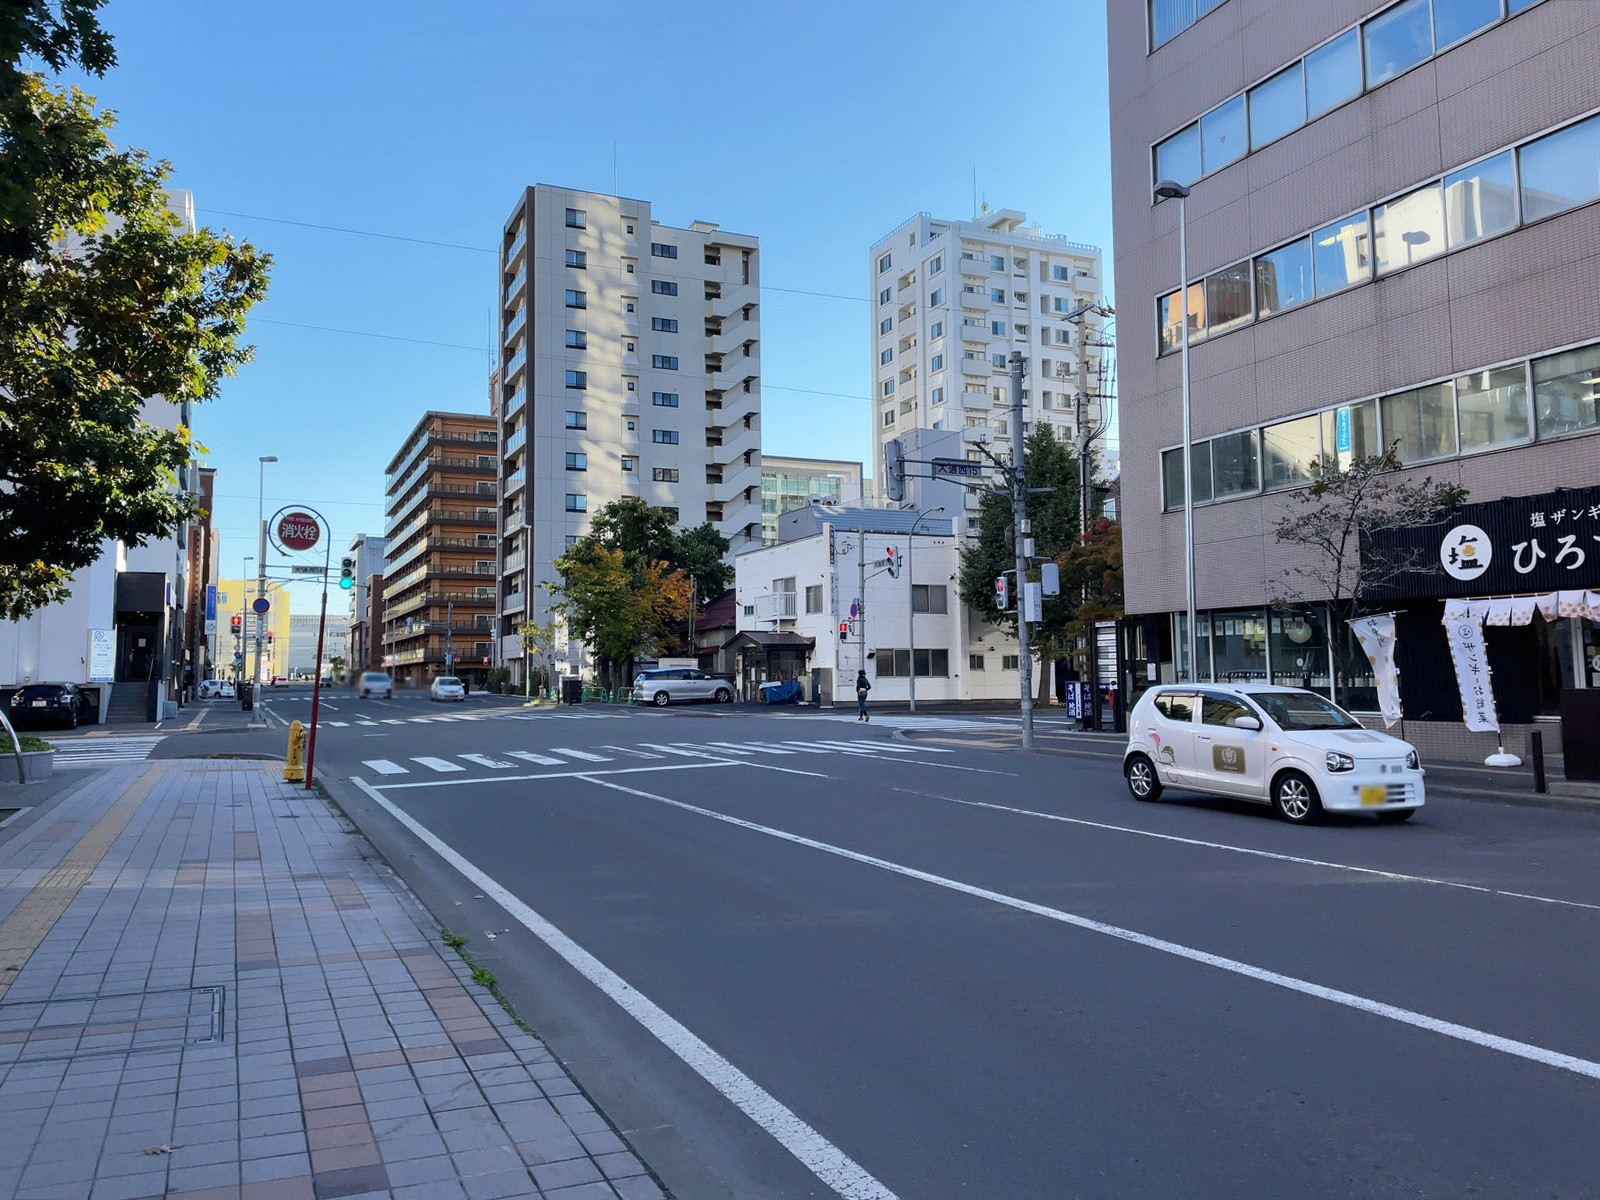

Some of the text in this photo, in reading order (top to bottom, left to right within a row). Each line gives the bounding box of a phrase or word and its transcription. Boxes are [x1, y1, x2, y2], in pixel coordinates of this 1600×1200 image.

[281, 523, 316, 540] 消火栓
[1511, 533, 1600, 575] ひろ
